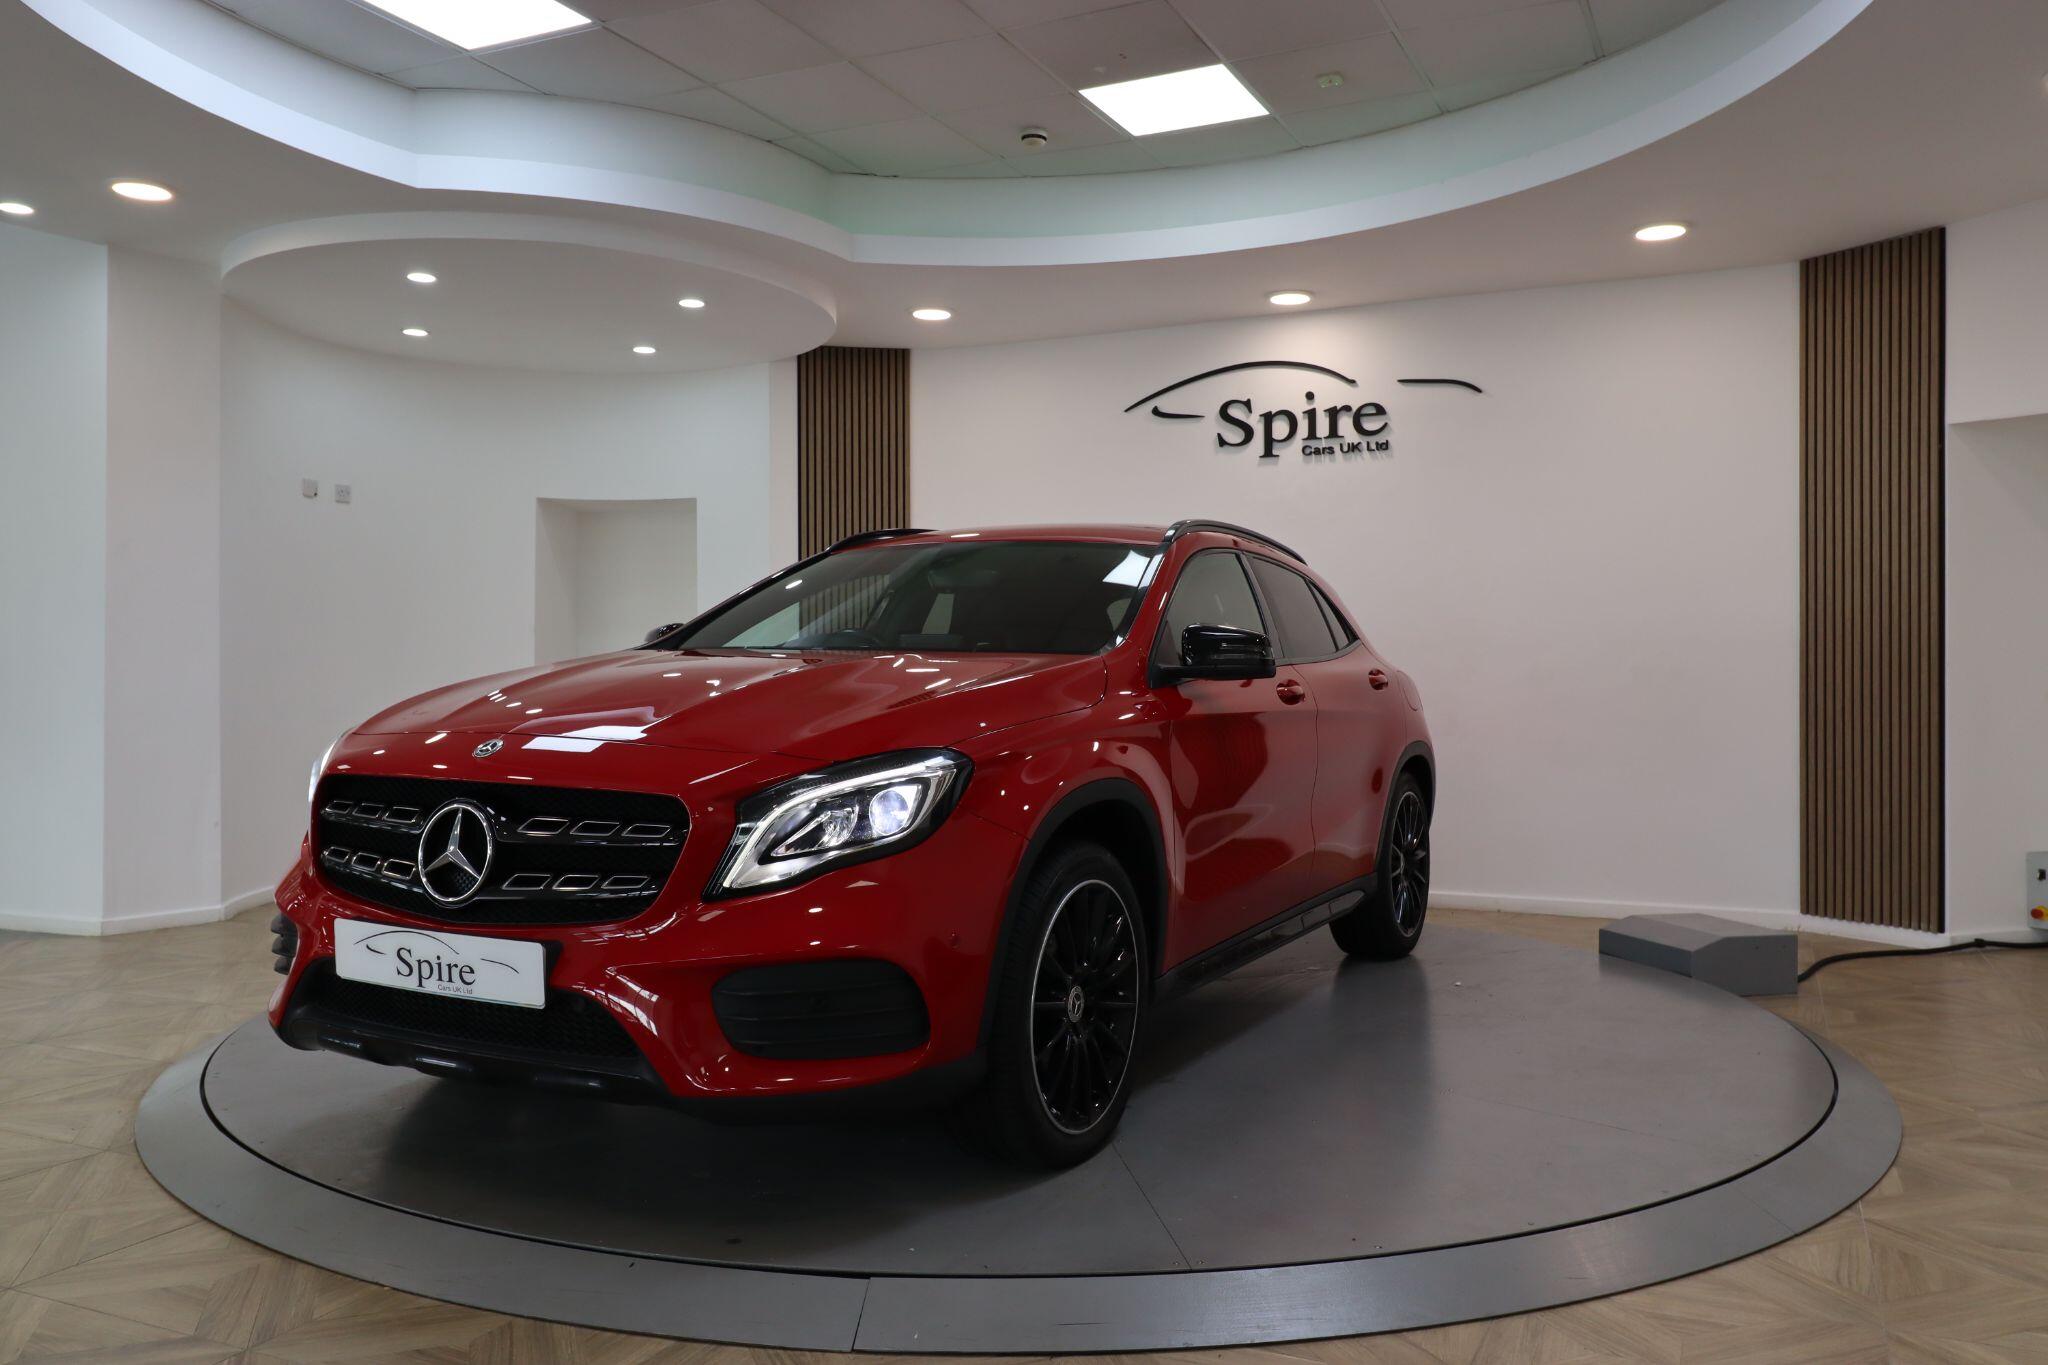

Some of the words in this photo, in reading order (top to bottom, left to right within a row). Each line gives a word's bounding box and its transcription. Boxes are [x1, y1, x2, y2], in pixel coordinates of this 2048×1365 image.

[1216, 391, 1388, 458] Spire
[1301, 445, 1335, 456] Cars
[1339, 441, 1362, 454] UK
[1366, 439, 1389, 452] Ltd
[396, 947, 476, 988] Spire
[437, 984, 451, 992] Cars
[452, 985, 462, 993] UK
[463, 987, 473, 995] Ltd
